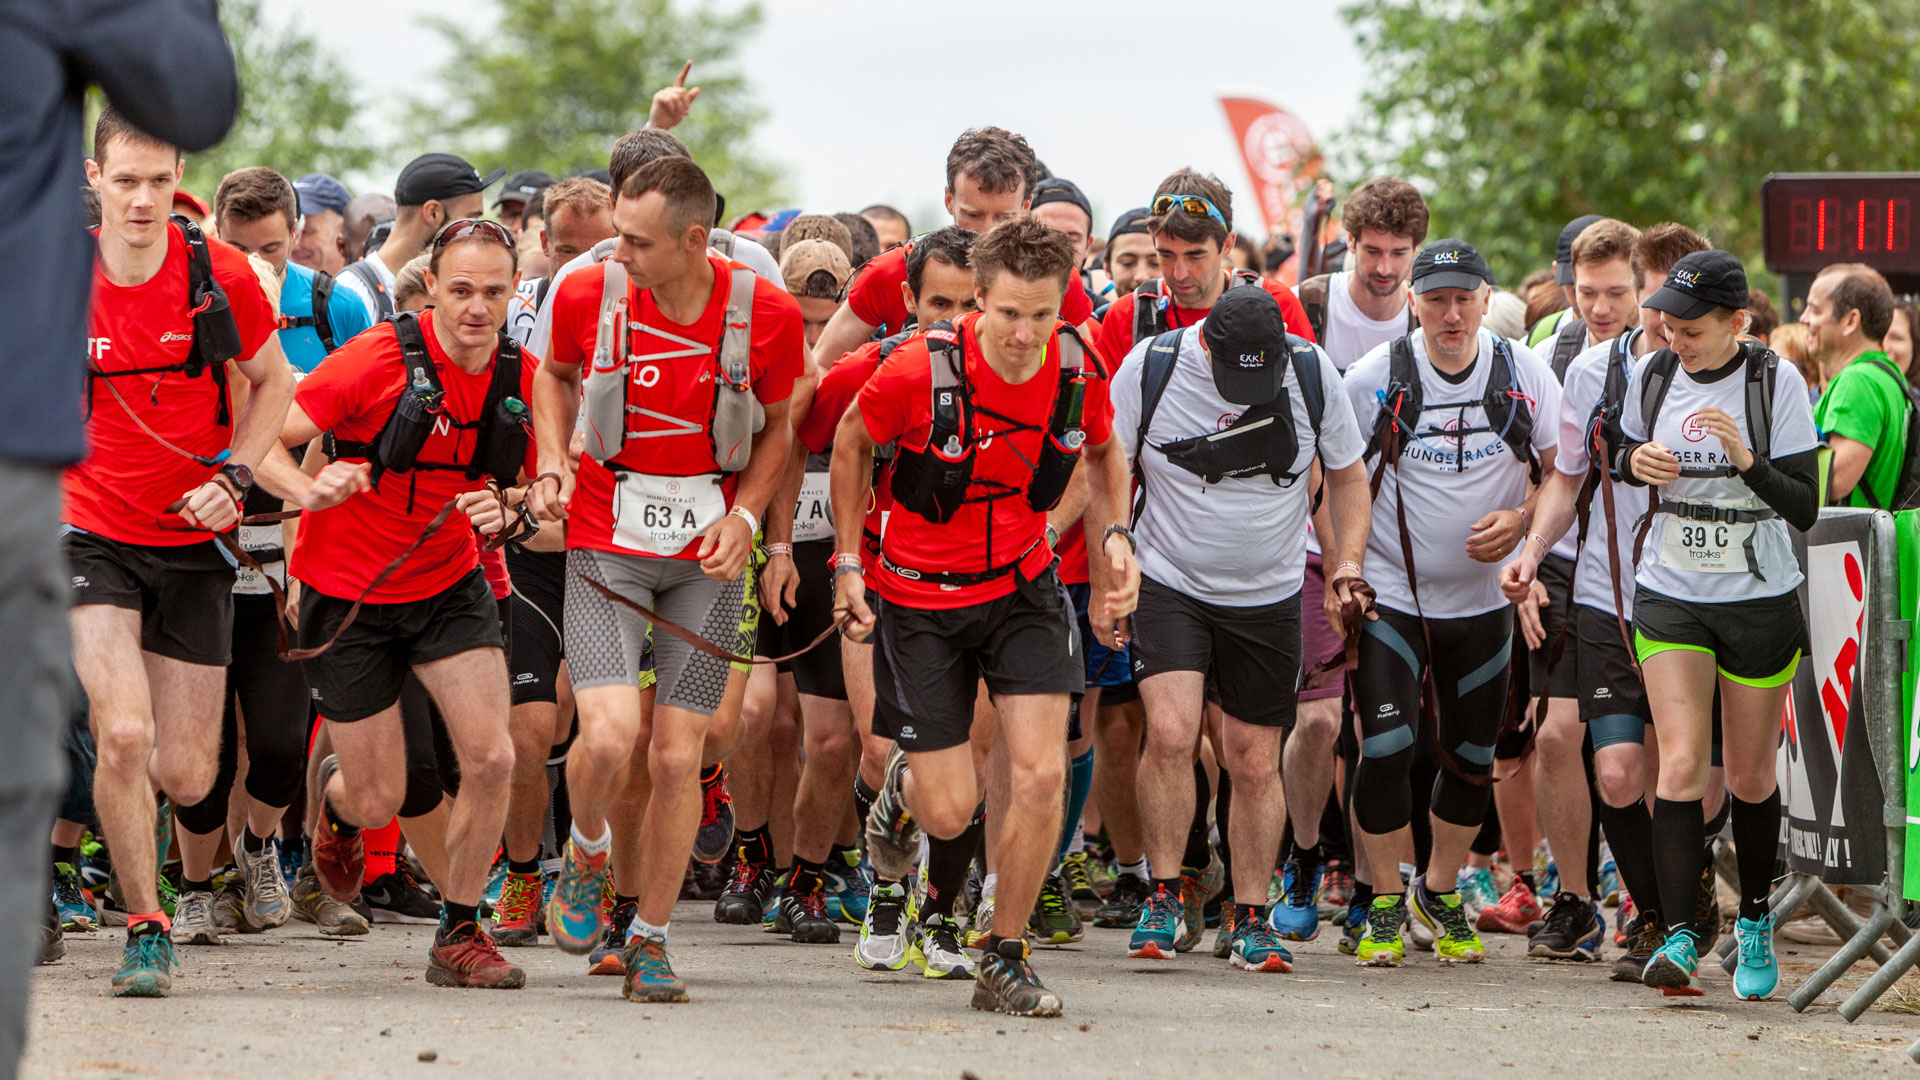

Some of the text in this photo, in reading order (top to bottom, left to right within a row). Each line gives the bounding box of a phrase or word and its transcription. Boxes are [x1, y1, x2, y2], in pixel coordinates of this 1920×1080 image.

[1464, 442, 1504, 462] RACE
[646, 494, 696, 504] HUNGER RACE
[643, 504, 697, 529] 63 A
[810, 500, 823, 519] A
[1682, 526, 1728, 548] 39 C
